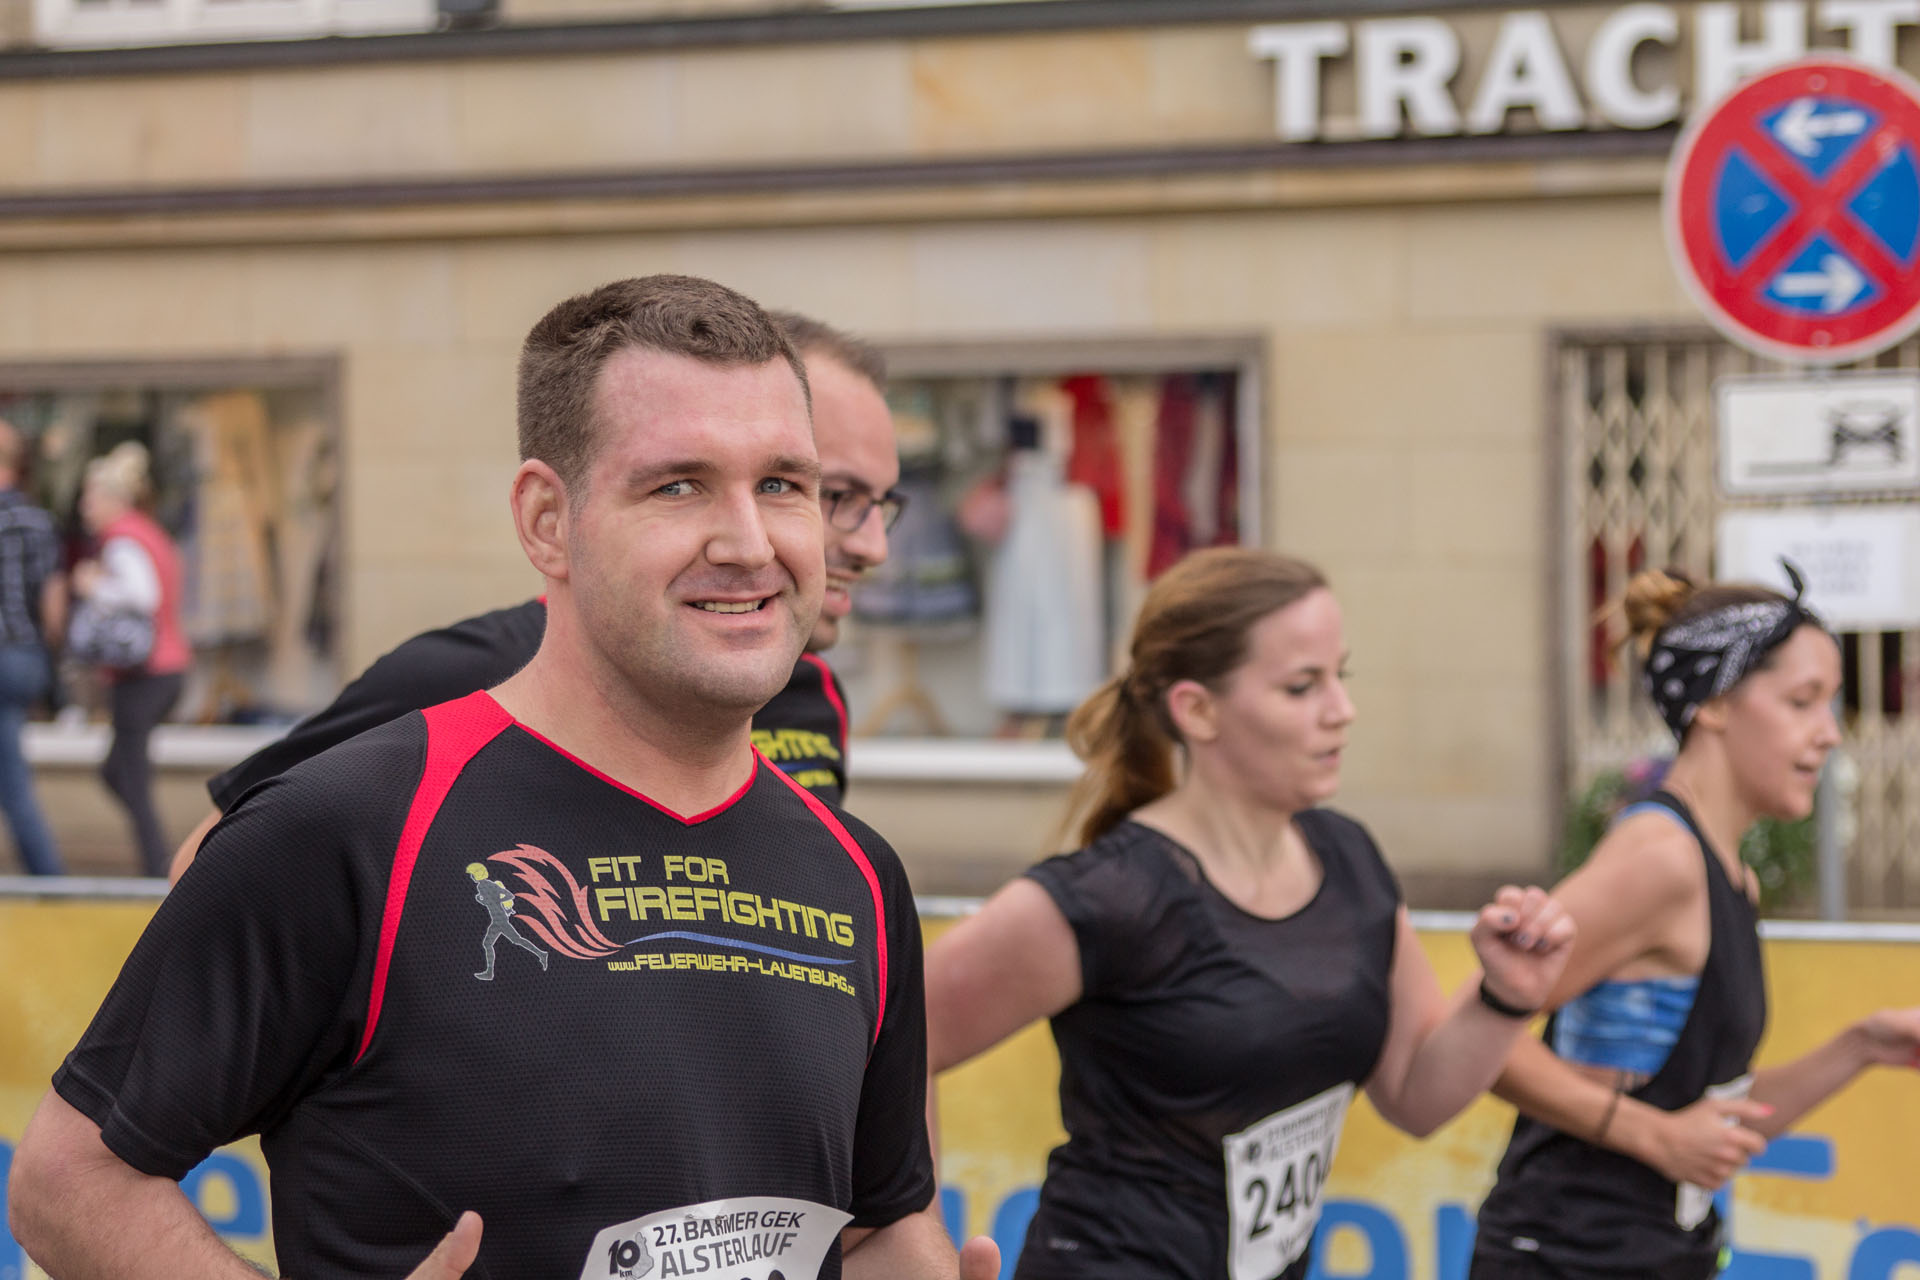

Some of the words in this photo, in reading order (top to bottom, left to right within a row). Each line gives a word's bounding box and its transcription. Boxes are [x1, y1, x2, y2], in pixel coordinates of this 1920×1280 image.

[1247, 0, 1920, 142] TRACHT
[588, 856, 641, 882] FIT
[664, 856, 730, 884] FOR
[595, 887, 855, 947] FIREFIGHTING
[653, 1224, 682, 1247] 27.
[684, 1211, 758, 1241] BARMER
[761, 1211, 806, 1228] GEK
[608, 1239, 641, 1275] 10
[619, 1269, 633, 1278] km
[661, 1232, 797, 1279] ALSTERLAUF
